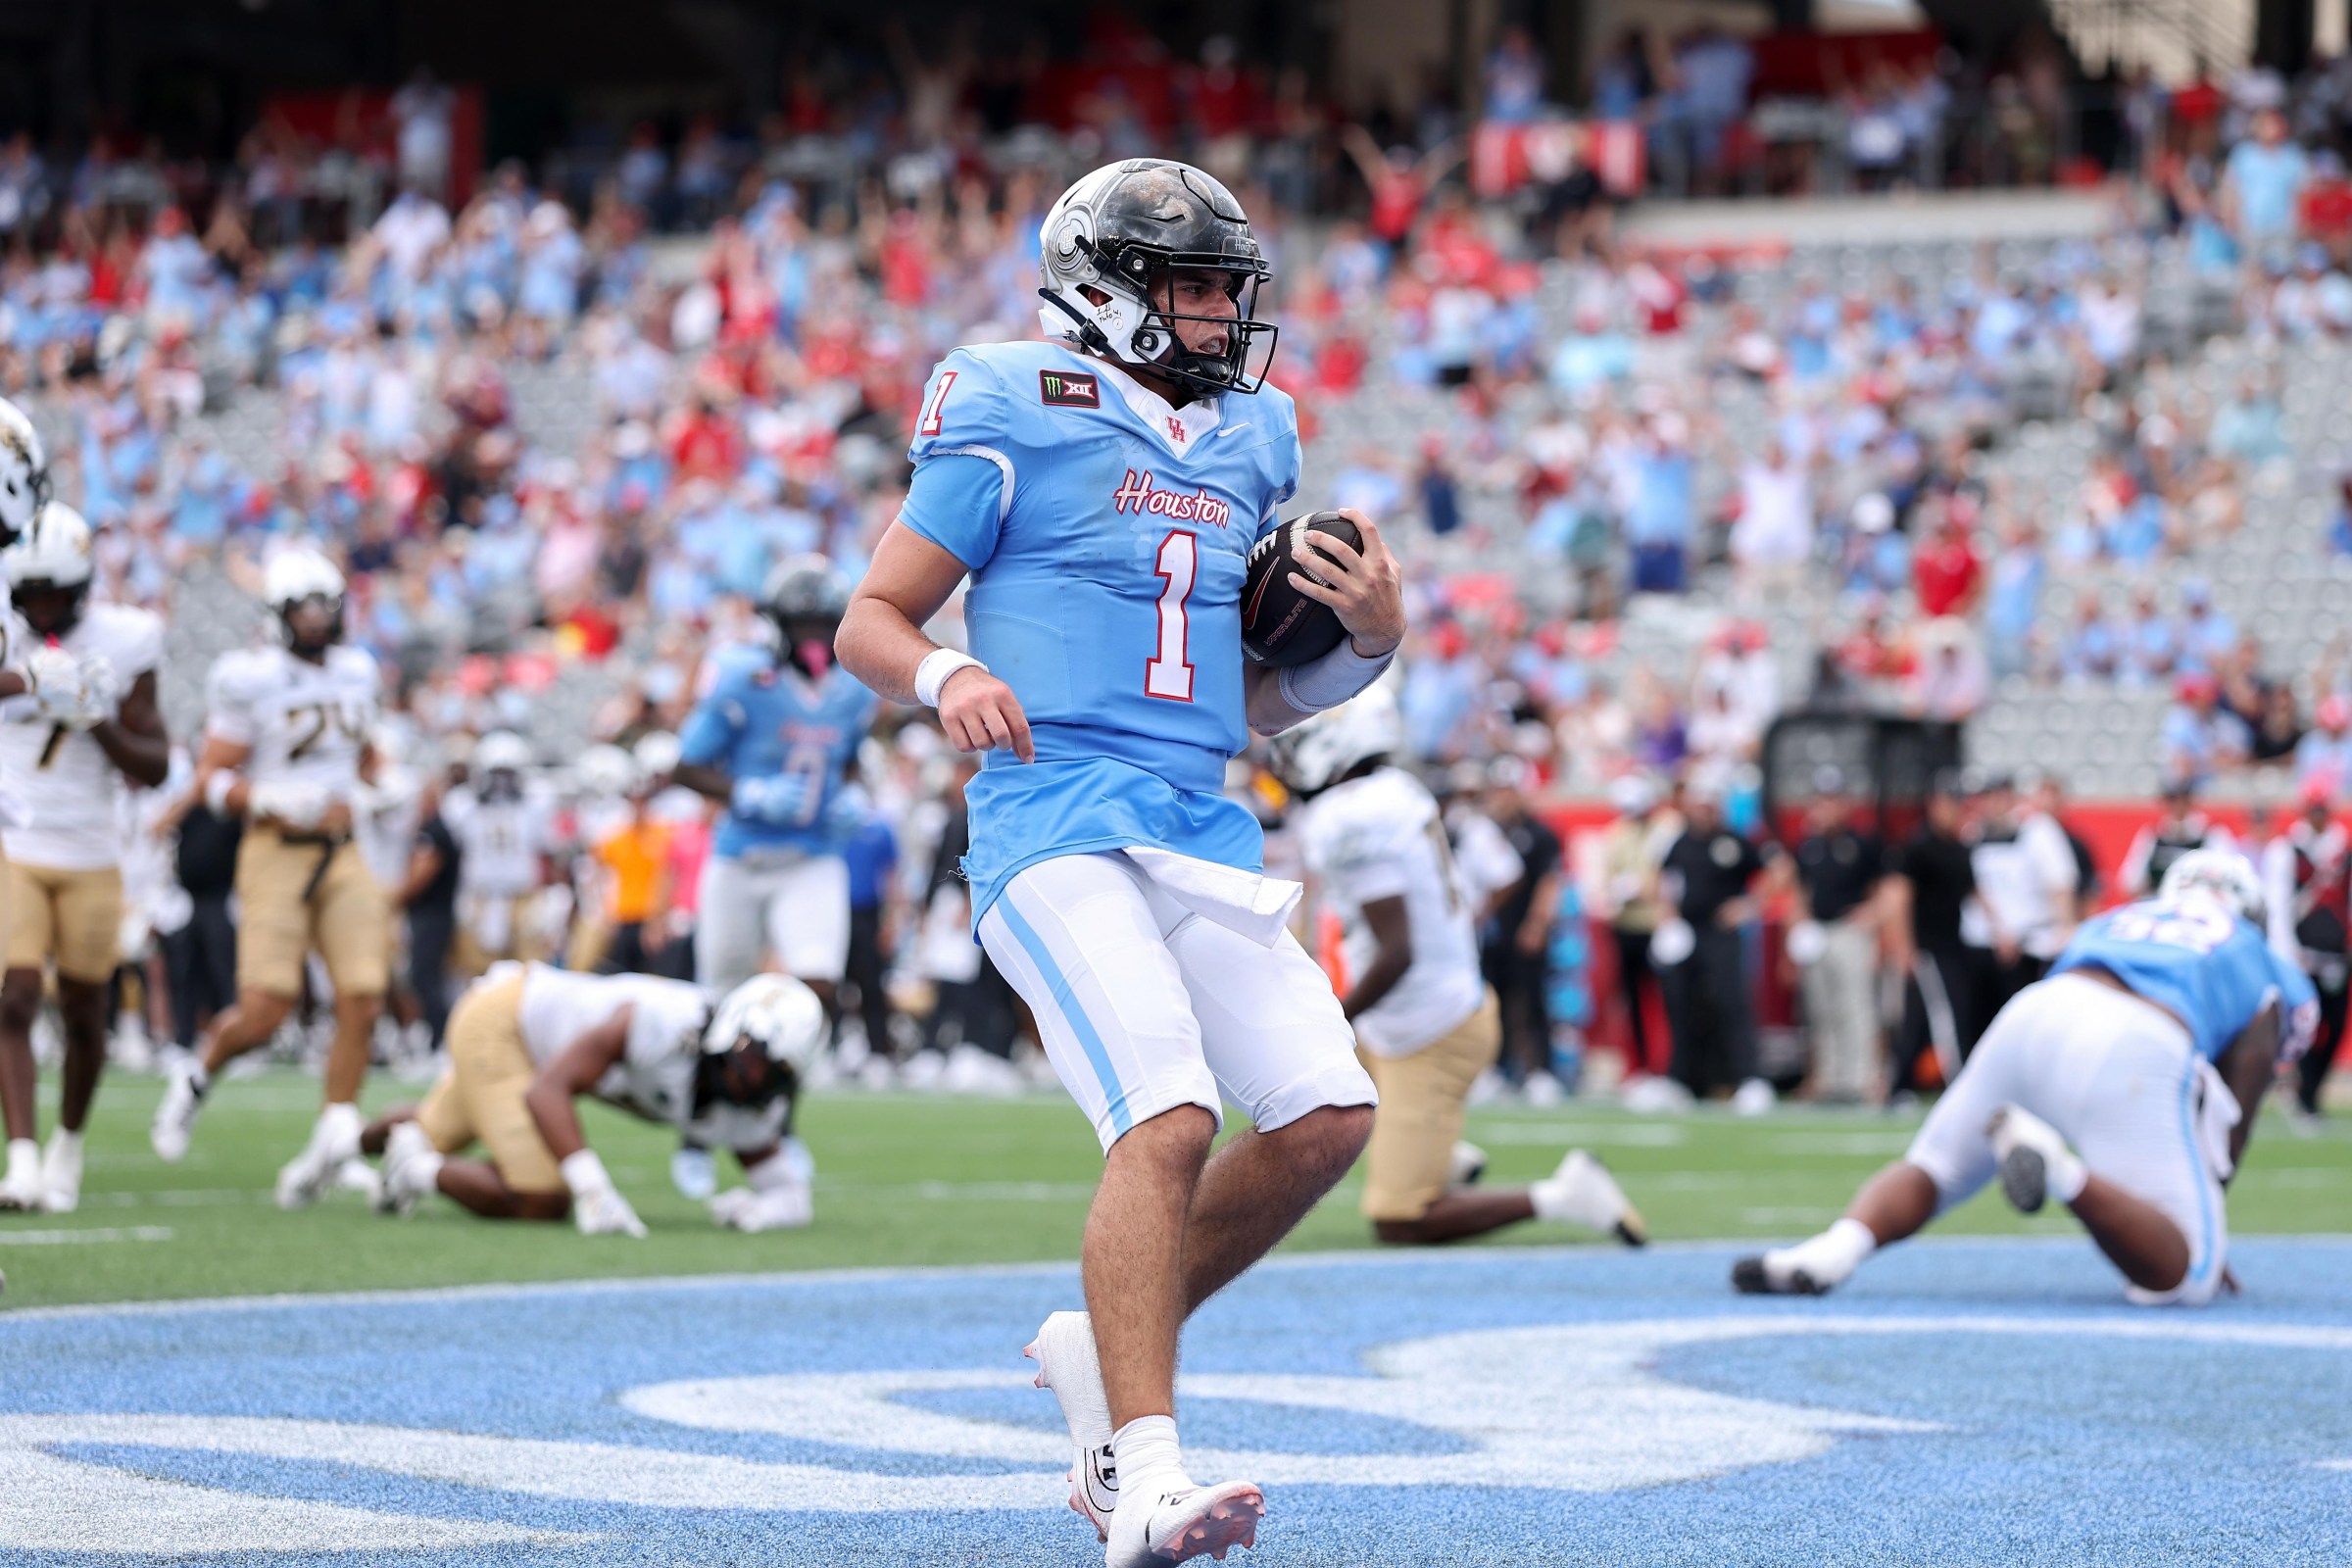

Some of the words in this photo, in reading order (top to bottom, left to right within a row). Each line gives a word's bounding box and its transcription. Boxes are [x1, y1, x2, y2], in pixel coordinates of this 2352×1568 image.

[920, 371, 958, 436] 1
[1165, 415, 1186, 444] UH
[1112, 467, 1230, 530] Houston
[1145, 529, 1197, 704] 1
